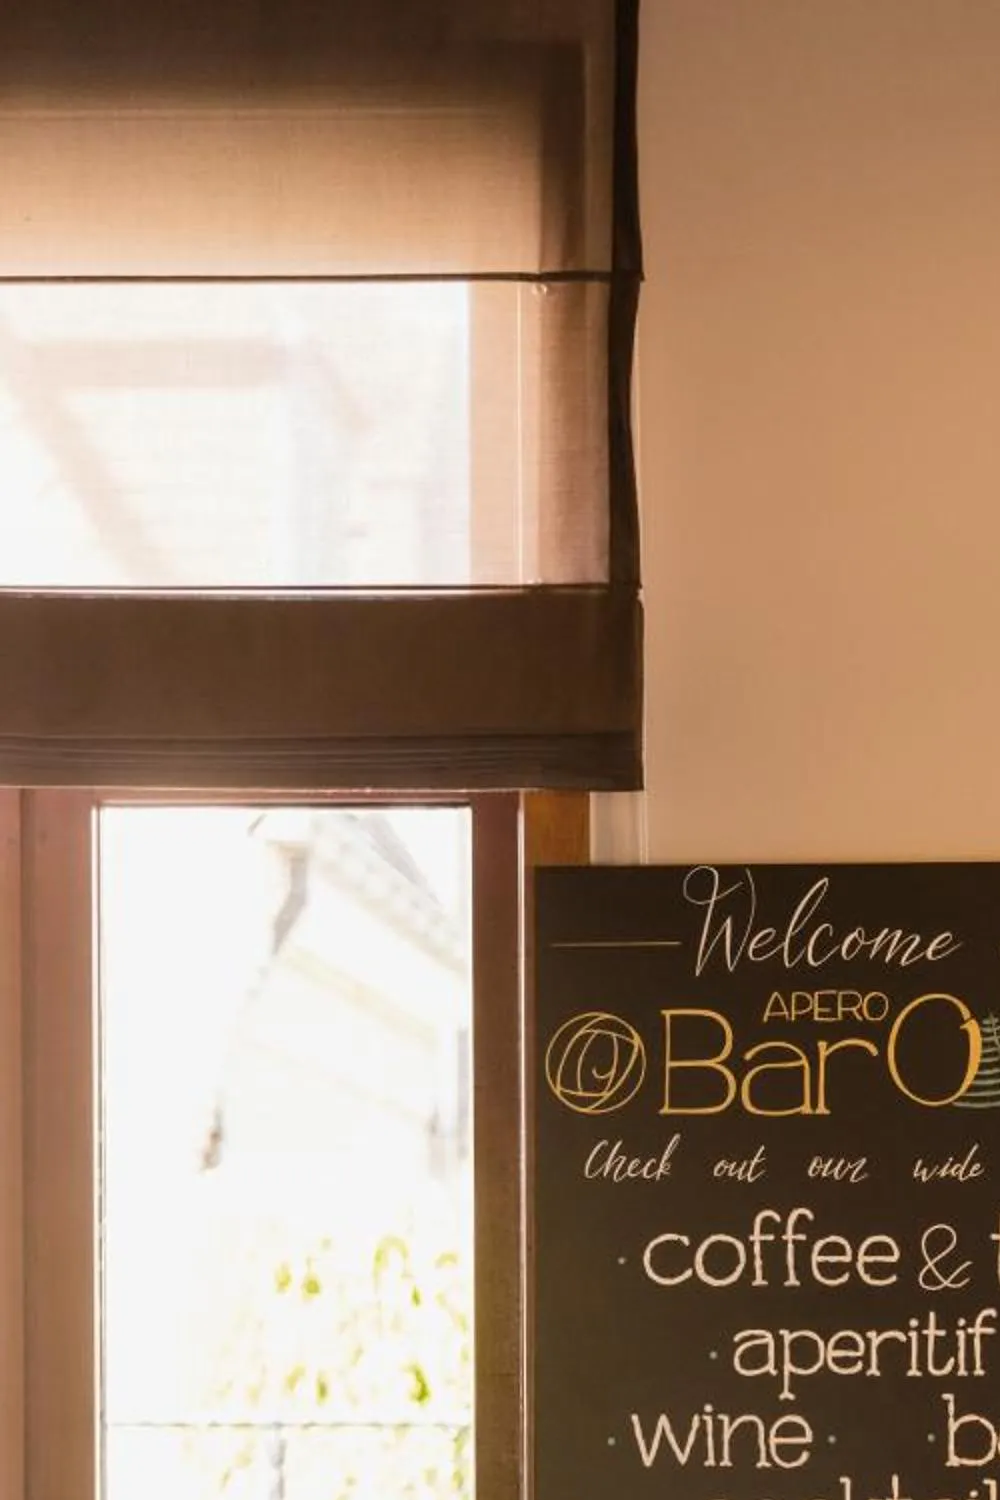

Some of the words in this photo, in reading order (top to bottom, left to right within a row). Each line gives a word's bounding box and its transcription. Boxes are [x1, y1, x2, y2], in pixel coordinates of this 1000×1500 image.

[683, 865, 962, 978] Welcome
[763, 990, 890, 1023] APERO
[583, 1133, 682, 1183] Check
[712, 1144, 767, 1183] out
[806, 1150, 869, 1183] our
[911, 1144, 985, 1183] wide
[642, 1208, 901, 1286] coffee
[918, 1224, 973, 1291] &
[732, 1308, 998, 1400] aperitif
[630, 1404, 813, 1469] wine
